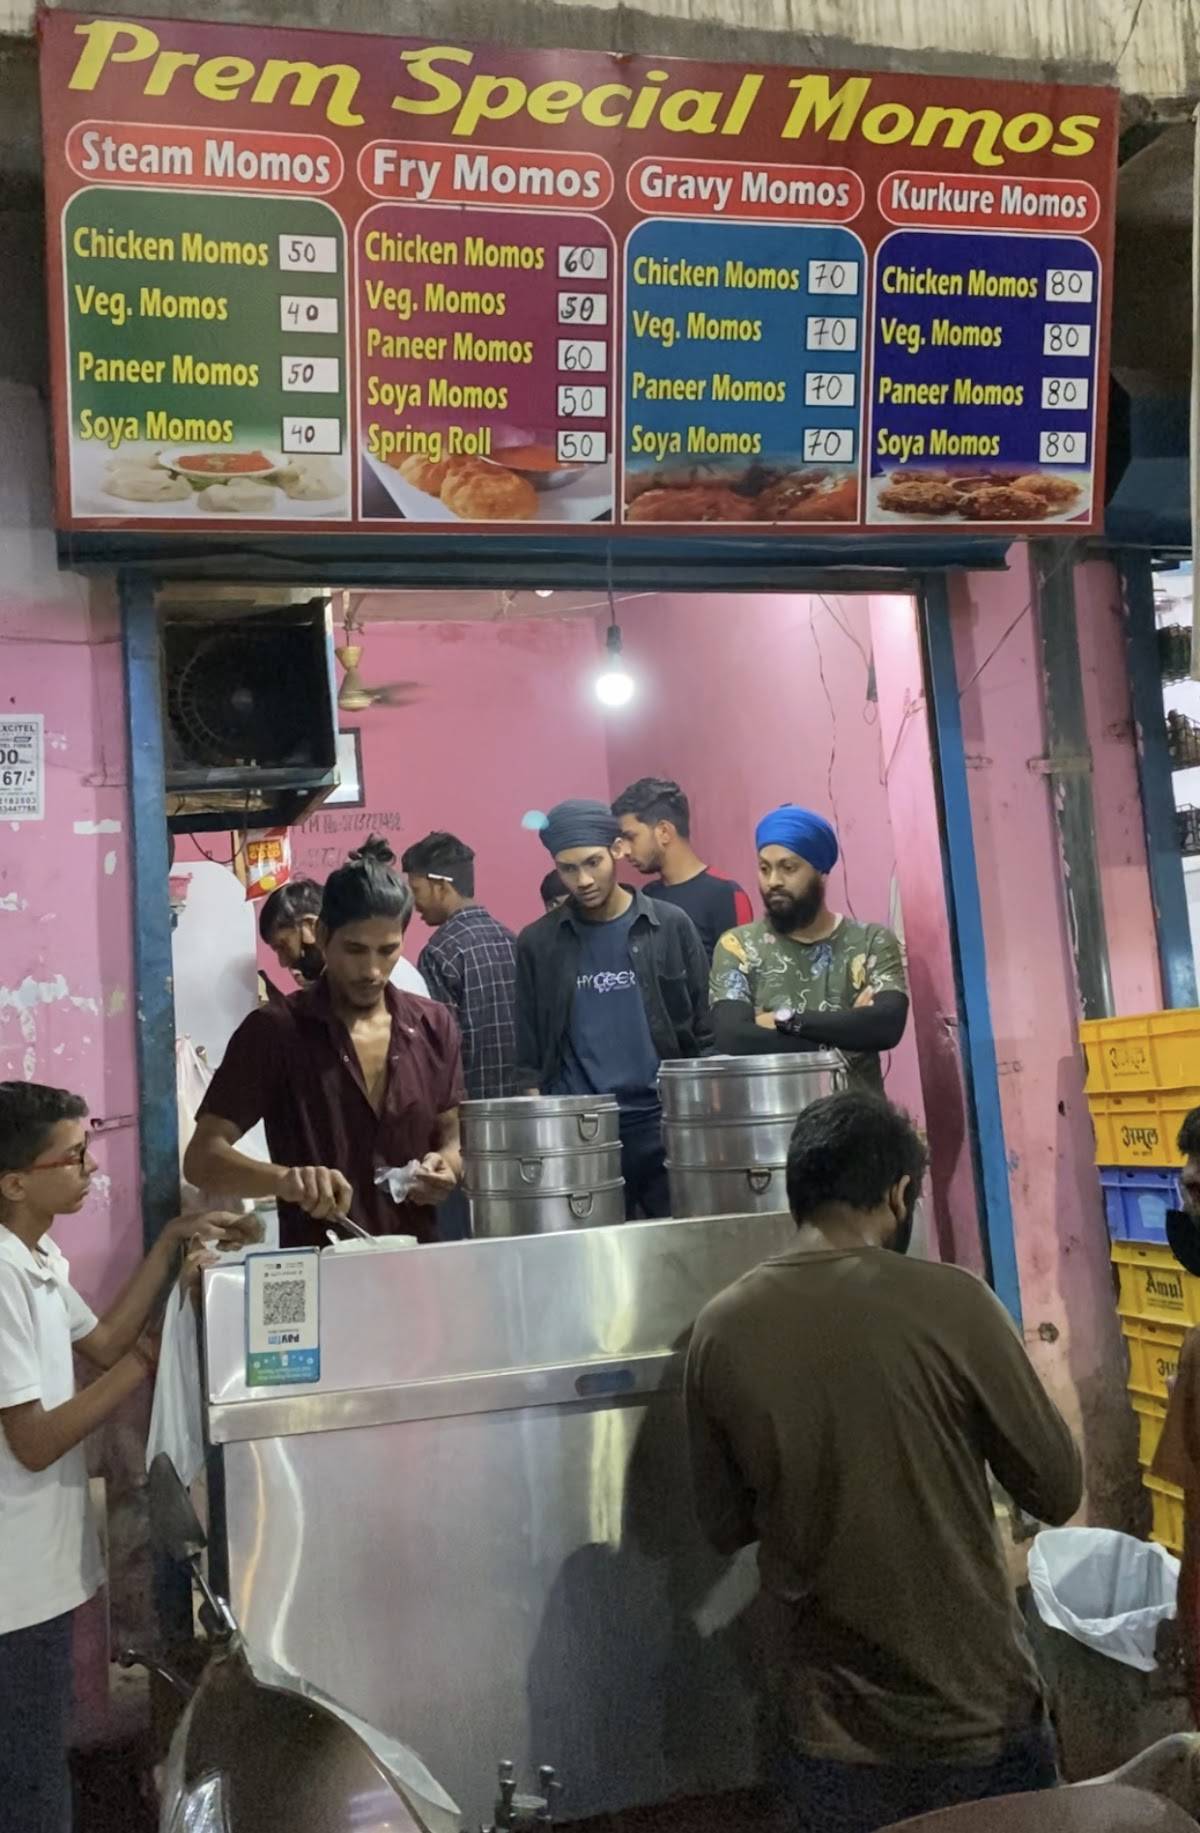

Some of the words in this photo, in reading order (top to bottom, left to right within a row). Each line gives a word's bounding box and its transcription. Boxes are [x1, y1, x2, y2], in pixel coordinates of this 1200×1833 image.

[68, 19, 365, 127] Prem
[391, 46, 764, 136] Special
[780, 74, 1100, 167] Momos
[82, 131, 193, 175] Steam
[204, 139, 330, 184] Momos
[373, 148, 441, 200] Fry
[453, 153, 600, 198] Momos
[640, 165, 733, 211] Gravy
[741, 171, 850, 207] Momos
[891, 179, 994, 214] Kurkure
[1000, 185, 1087, 219] Momos
[73, 226, 174, 261] Chicken
[181, 232, 269, 267] Momos
[288, 241, 316, 263] 50
[365, 231, 458, 265] Chicken
[464, 236, 545, 270] Momos
[564, 246, 595, 273] 60
[633, 256, 719, 288] Chicken
[725, 260, 799, 291] Momos
[815, 263, 846, 289] 70
[882, 265, 962, 296] Chicken
[967, 269, 1038, 298] Momos
[1051, 271, 1082, 296] 80
[74, 284, 133, 326] Veg.
[140, 287, 228, 321] Momos
[287, 301, 319, 325] 40
[365, 280, 418, 320] Veg.
[425, 283, 506, 316] Momos
[561, 296, 594, 321] 50
[367, 328, 447, 361] Paneer
[453, 331, 533, 364] Momos
[564, 344, 593, 370] 60
[632, 310, 680, 348] Veg.
[687, 312, 762, 342] Momos
[814, 318, 846, 346] 70
[880, 317, 925, 354] Veg.
[931, 319, 1002, 347] Momos
[1049, 324, 1079, 352] 80
[78, 351, 166, 384] Paneer
[172, 355, 259, 387] Momos
[287, 363, 314, 385] 50
[632, 371, 706, 401] Paneer
[711, 374, 786, 403] Momos
[811, 375, 843, 401] 70
[367, 376, 421, 415] Soya
[428, 378, 508, 409] Momos
[562, 388, 593, 416] 50
[879, 377, 949, 404] Paneer
[953, 378, 1024, 406] Momos
[1047, 379, 1077, 406] 80
[80, 408, 138, 450] Soya
[146, 411, 233, 443] Momos
[291, 424, 315, 444] 40
[368, 423, 441, 464] Spring
[449, 425, 491, 455] Roll
[560, 434, 593, 458] 50
[631, 424, 681, 462] Soya
[687, 426, 761, 454] Momos
[808, 430, 841, 457] 70
[877, 428, 925, 464] Soya
[929, 429, 1000, 456] Momos
[1045, 432, 1075, 458] 80
[0, 724, 35, 732] XCITEL
[1145, 1270, 1183, 1299] Amul
